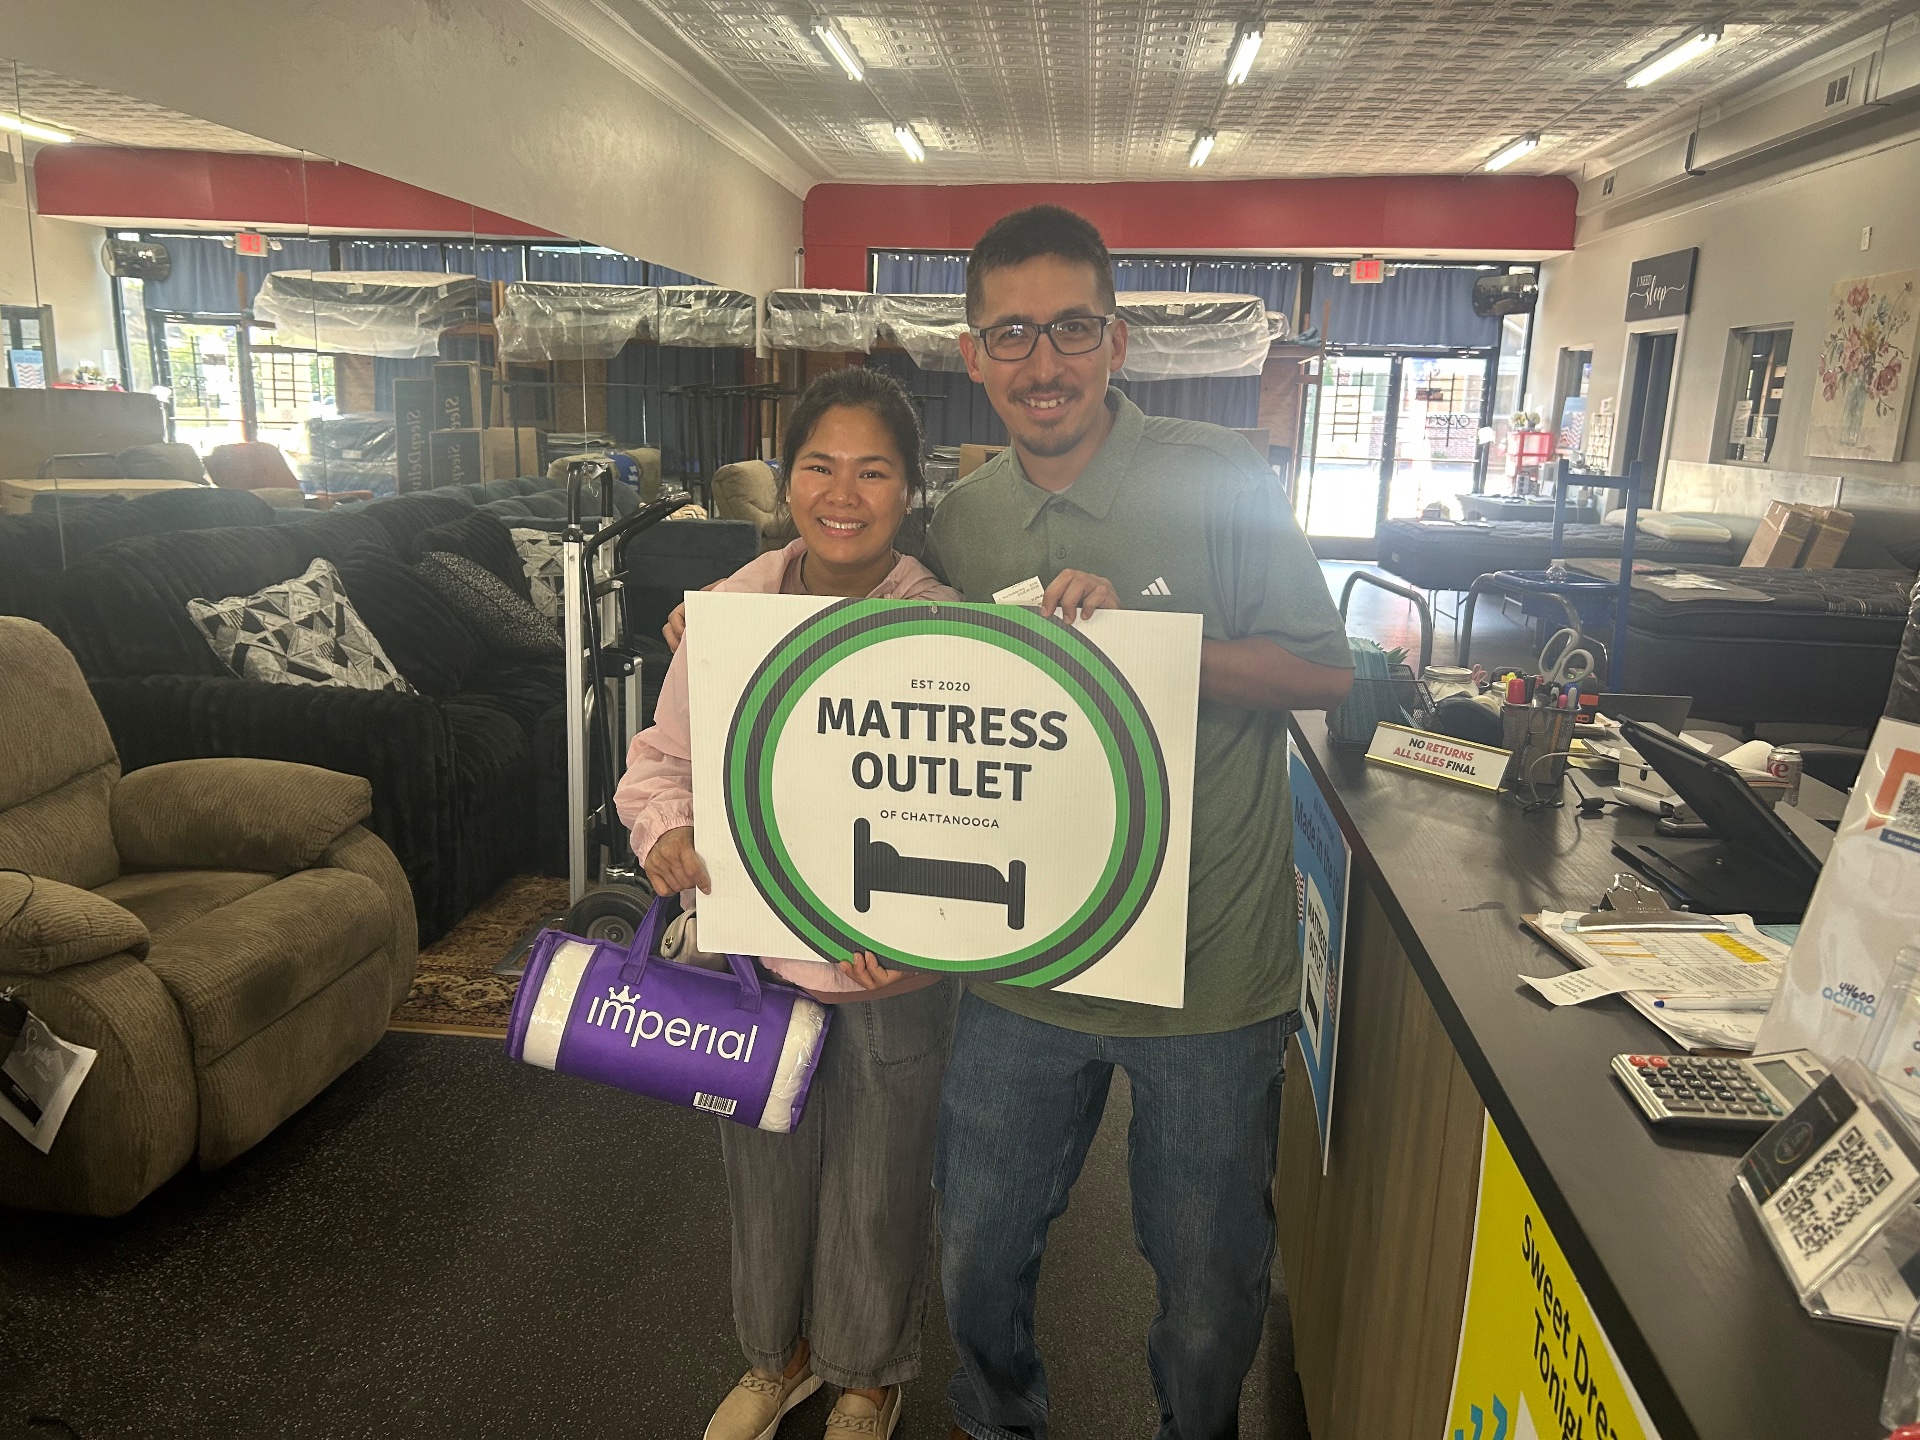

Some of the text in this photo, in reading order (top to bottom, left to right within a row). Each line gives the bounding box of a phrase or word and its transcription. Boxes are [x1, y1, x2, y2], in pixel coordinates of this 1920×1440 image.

[1356, 261, 1380, 279] EXIT
[1639, 274, 1652, 286] NEED
[911, 679, 971, 692] EST 2020
[817, 696, 1068, 751] MATTRESS
[1392, 746, 1476, 776] ALL SALES FINAL
[1408, 737, 1475, 762] NO RETURNS
[851, 751, 1032, 802] OUTLET
[880, 809, 1000, 829] OF CHATTANOOGA
[1294, 794, 1316, 850] Made
[1822, 987, 1876, 1019] acima
[1838, 982, 1875, 1004] 44600
[586, 996, 758, 1063] imperial
[1521, 1214, 1571, 1360] Sweet
